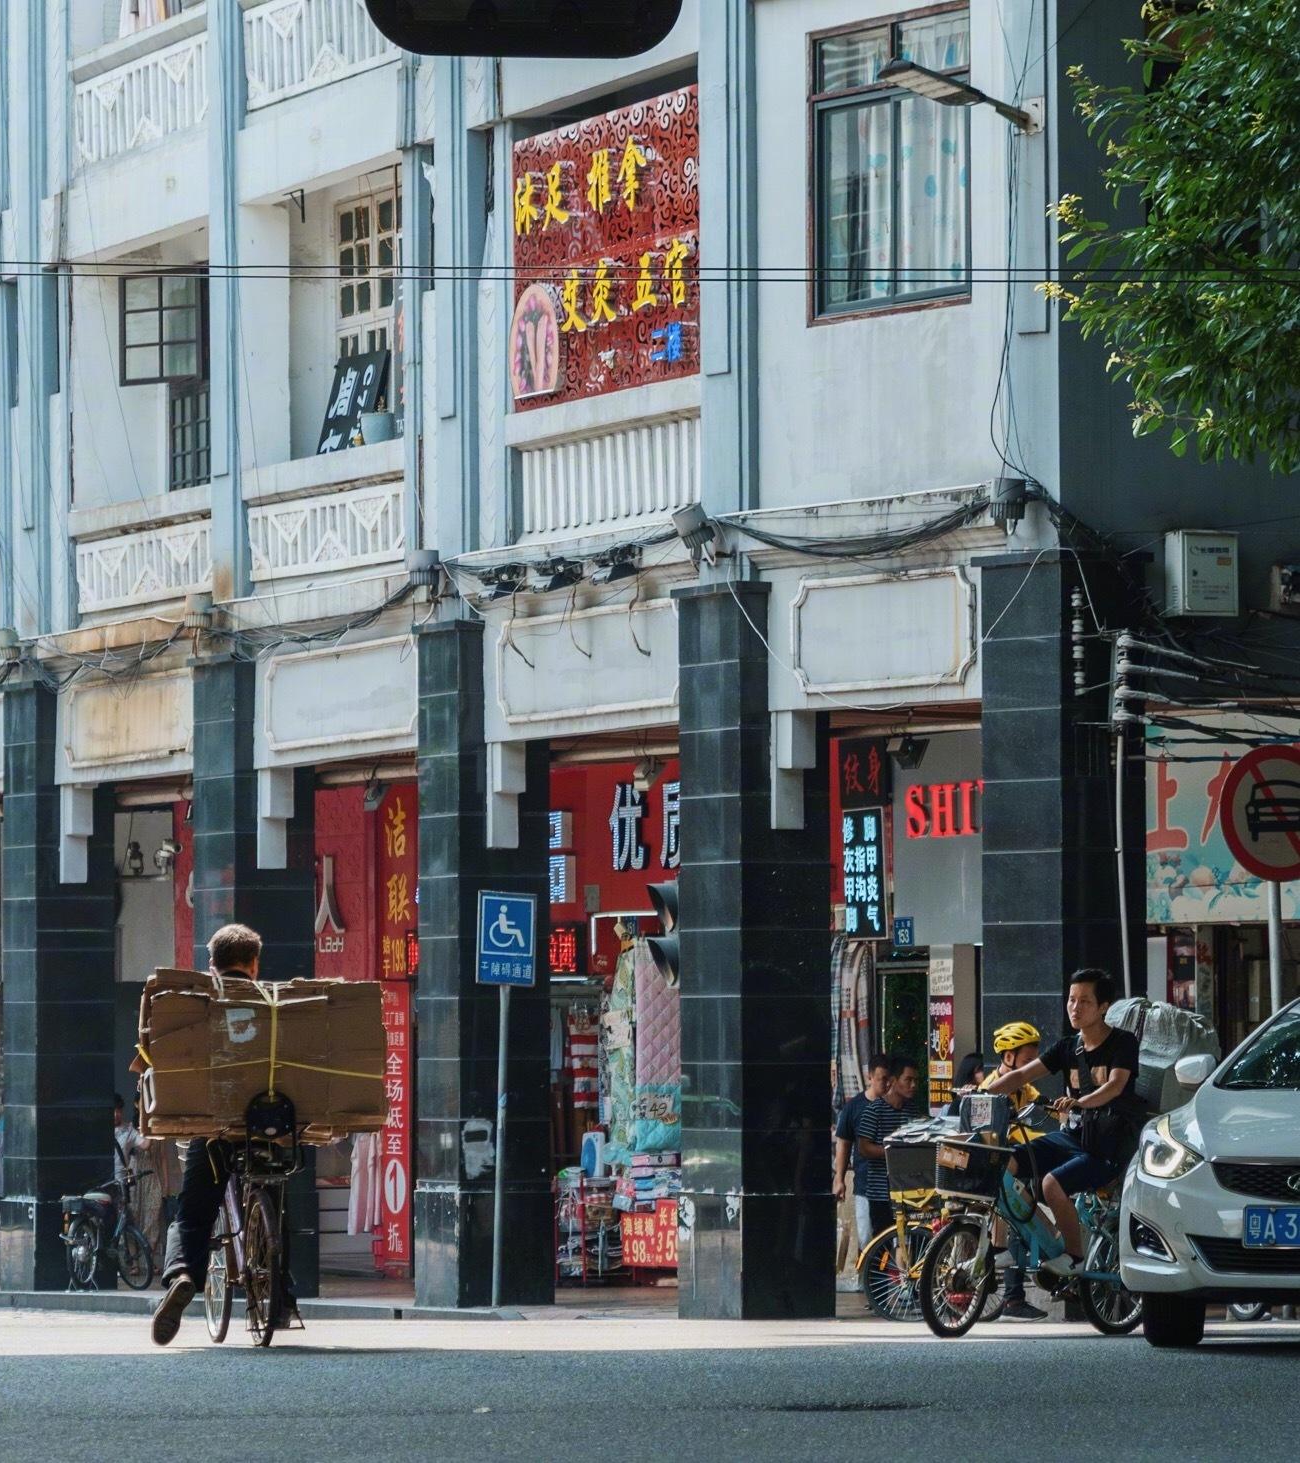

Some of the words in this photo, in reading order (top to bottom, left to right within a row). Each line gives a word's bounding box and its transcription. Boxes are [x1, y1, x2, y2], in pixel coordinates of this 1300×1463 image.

[905, 779, 983, 839] SHI
[843, 846, 878, 873] 灰指甲
[844, 874, 880, 903] 甲沟炎
